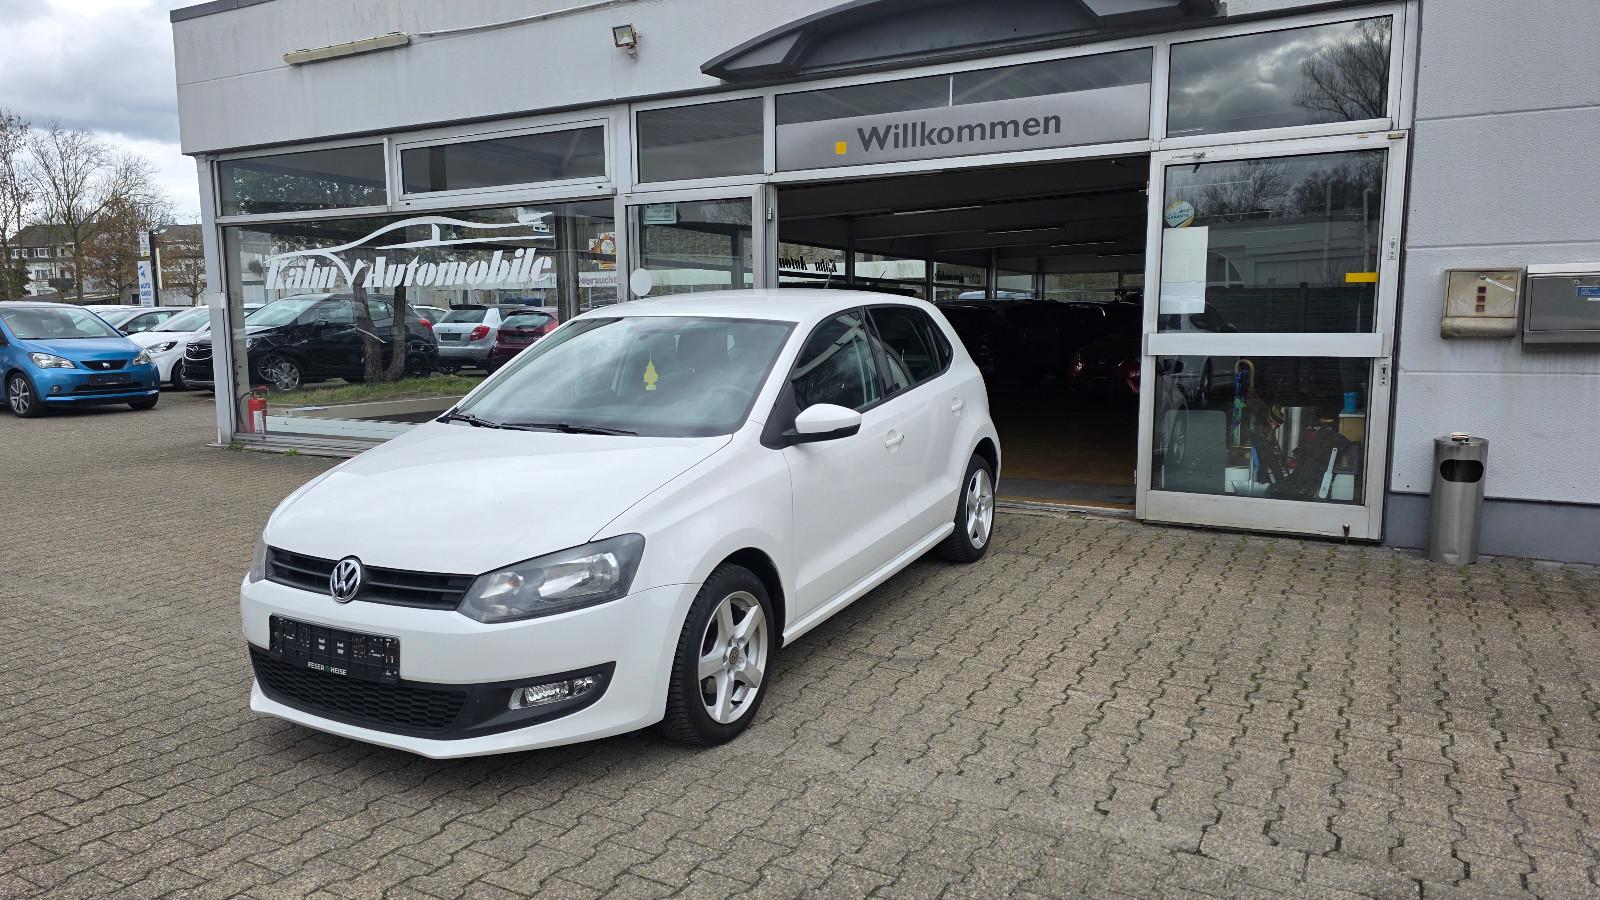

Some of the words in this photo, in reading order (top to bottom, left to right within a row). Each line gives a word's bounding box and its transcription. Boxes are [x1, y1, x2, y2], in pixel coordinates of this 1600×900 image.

[857, 114, 1062, 152] Willkommen
[265, 258, 338, 290] Kahn
[363, 247, 557, 289] Automobile
[330, 666, 347, 676] HEISE
